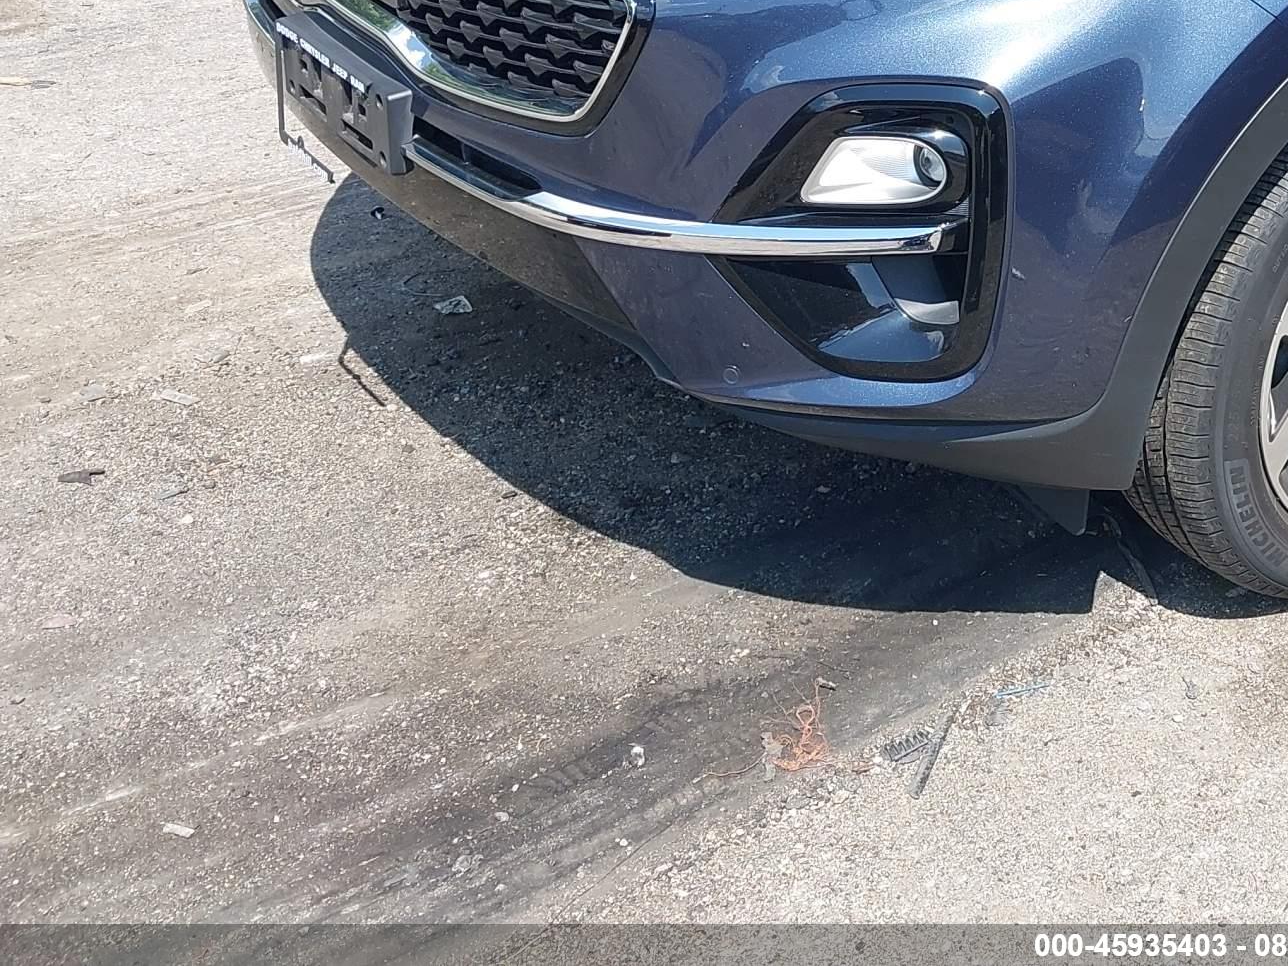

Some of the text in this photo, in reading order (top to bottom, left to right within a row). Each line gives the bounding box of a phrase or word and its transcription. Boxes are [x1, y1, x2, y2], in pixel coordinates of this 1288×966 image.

[275, 21, 366, 94] DODGE CHRYSLER JEEP RAM
[1229, 465, 1288, 568] MICHELIN
